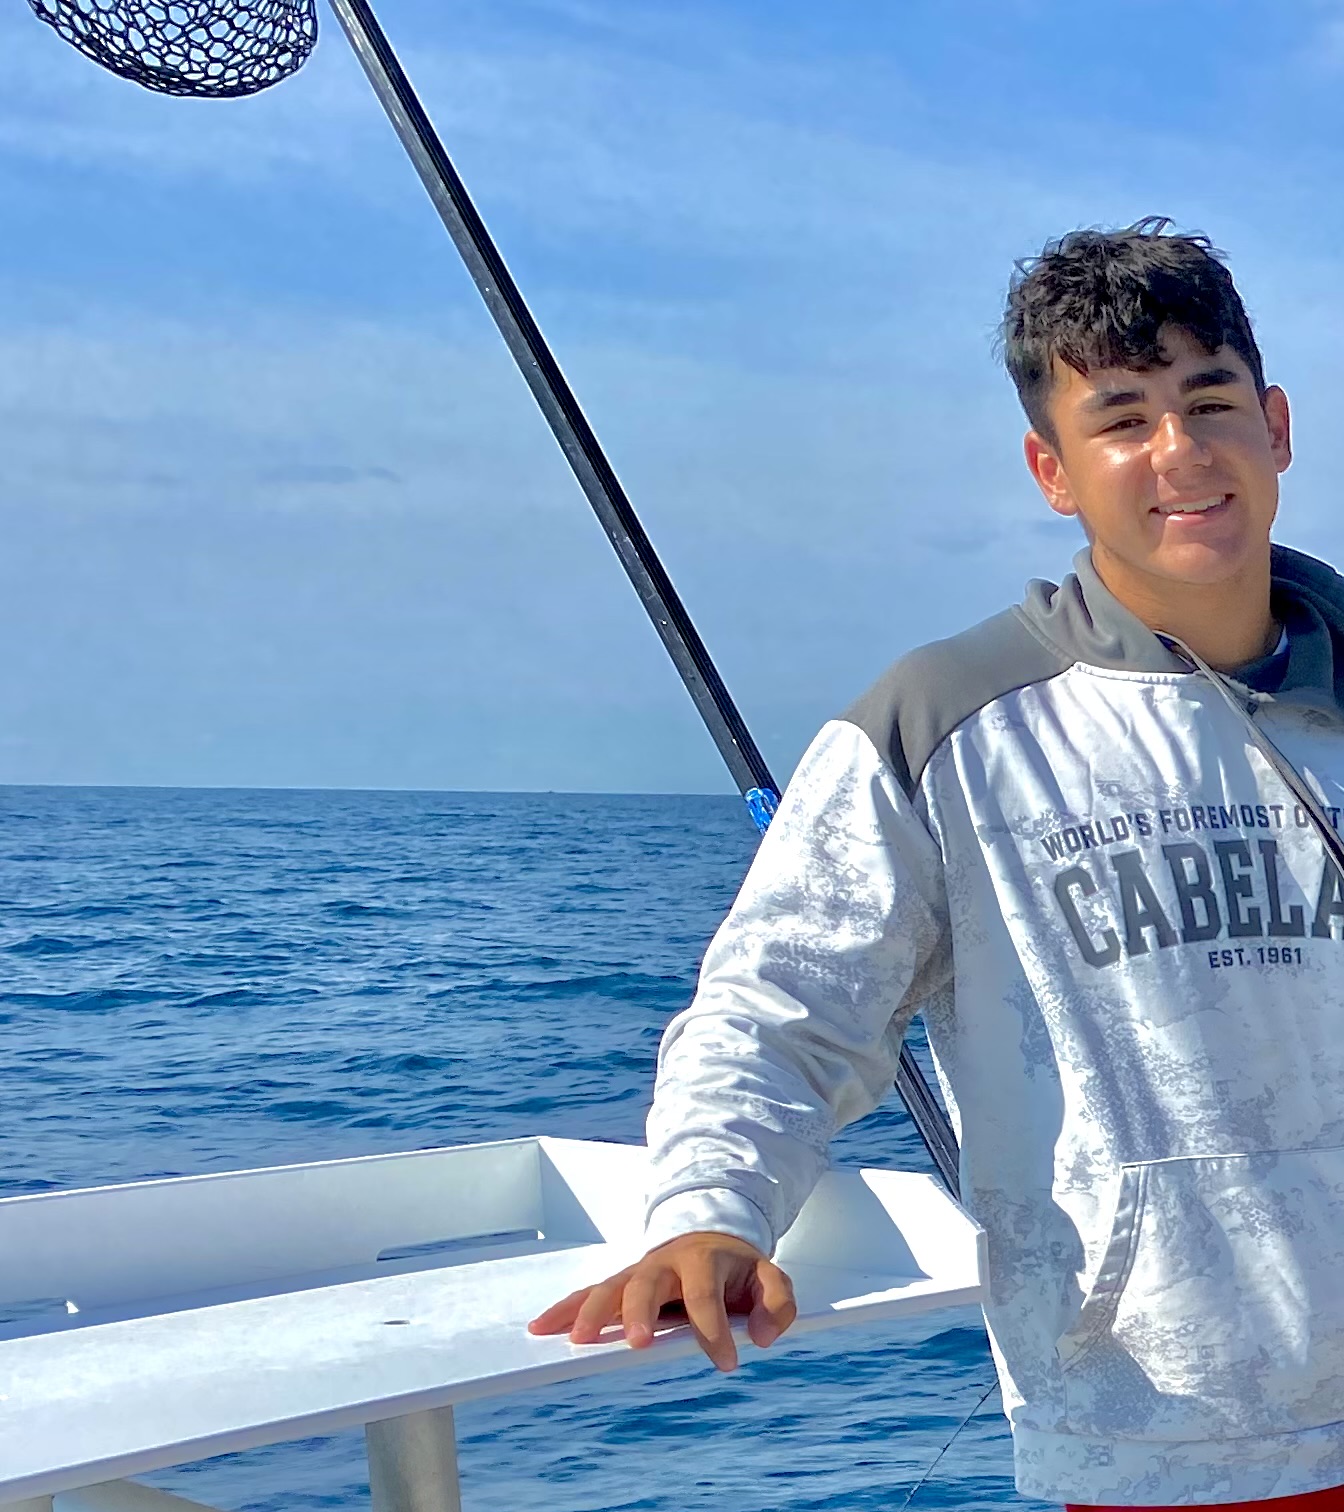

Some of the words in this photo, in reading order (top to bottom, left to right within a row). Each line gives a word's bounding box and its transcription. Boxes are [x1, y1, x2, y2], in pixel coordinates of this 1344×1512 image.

[1040, 813, 1152, 861] WORLD'S
[1159, 804, 1284, 833] FOREMOST
[1208, 949, 1251, 968] EST.
[1257, 946, 1302, 965] 1961
